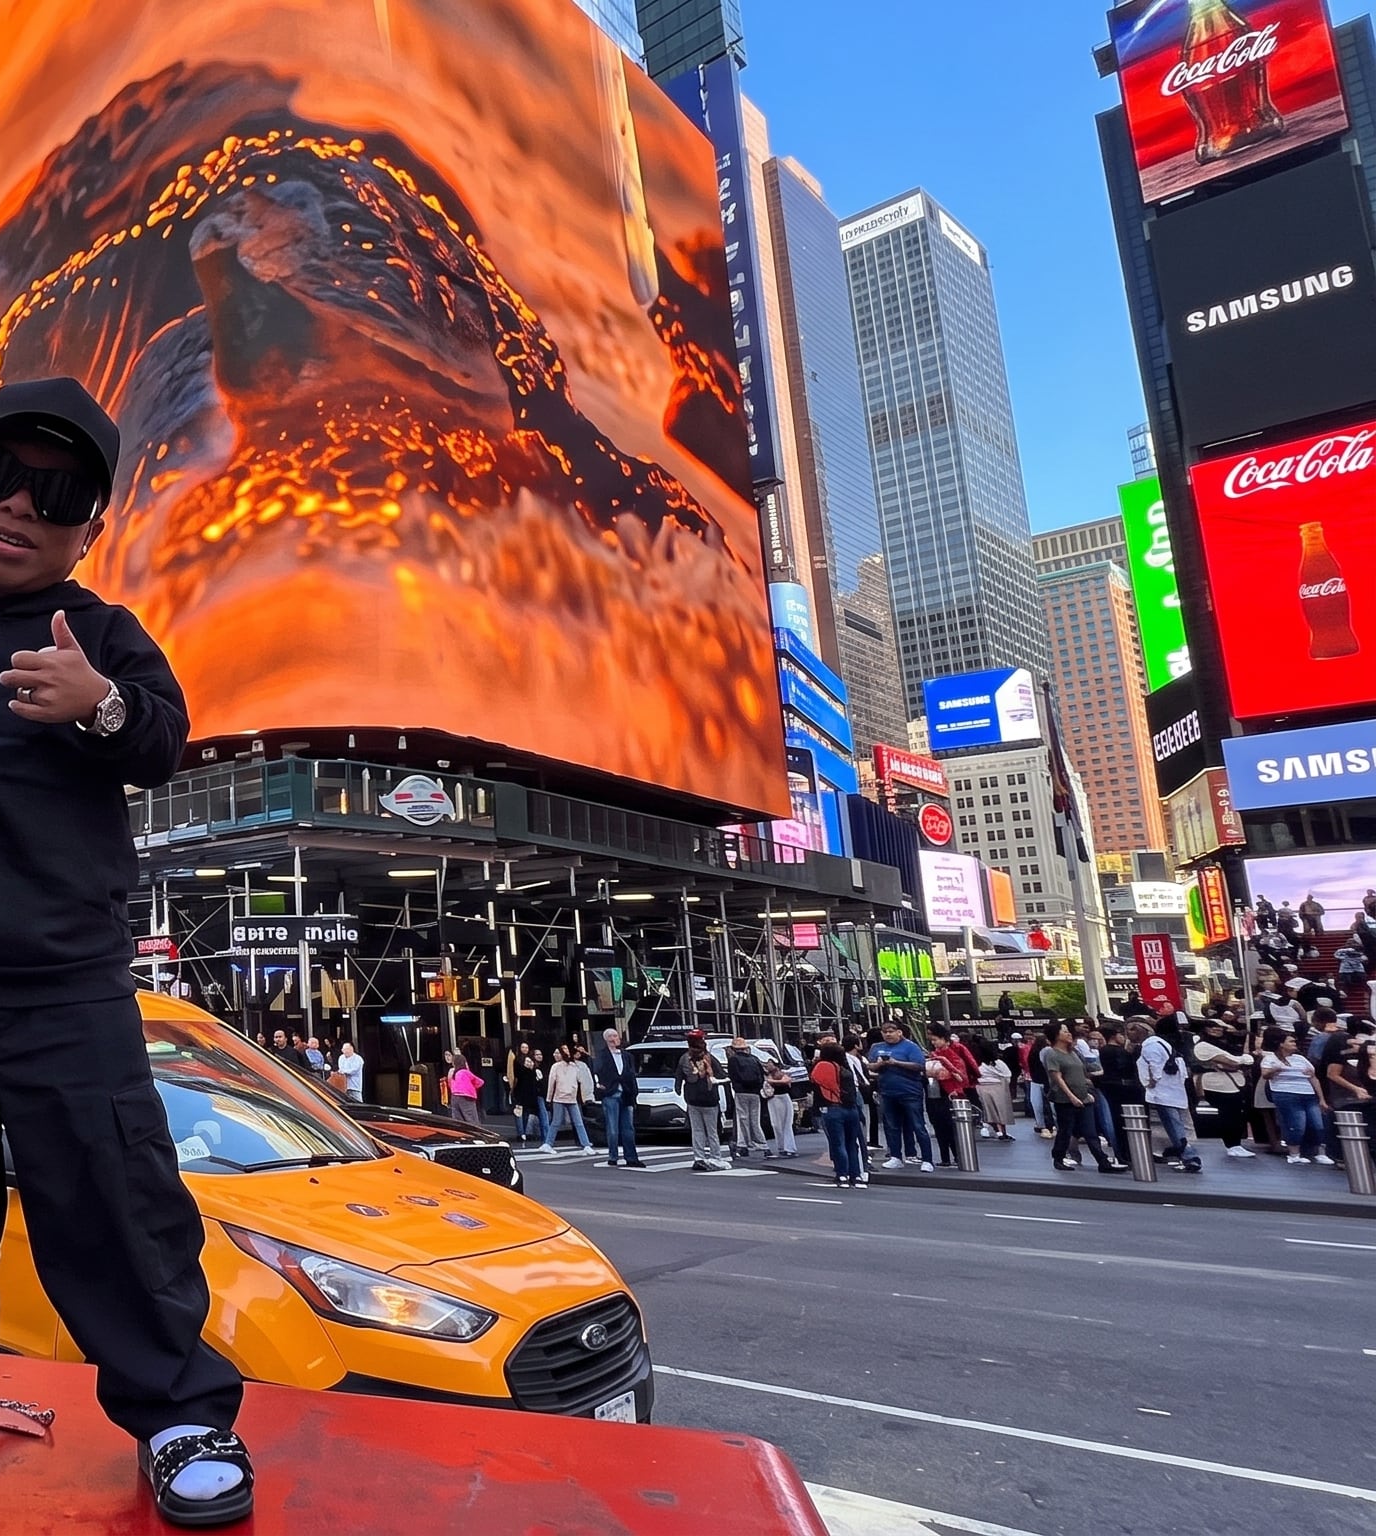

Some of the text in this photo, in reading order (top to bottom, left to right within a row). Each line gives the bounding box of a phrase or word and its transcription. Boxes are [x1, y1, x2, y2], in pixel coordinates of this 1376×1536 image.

[1160, 21, 1280, 96] Coca-Cola
[1186, 264, 1354, 333] SAMSUNG
[1224, 430, 1376, 498] Coca-Cola
[1257, 747, 1376, 784] SAMS
